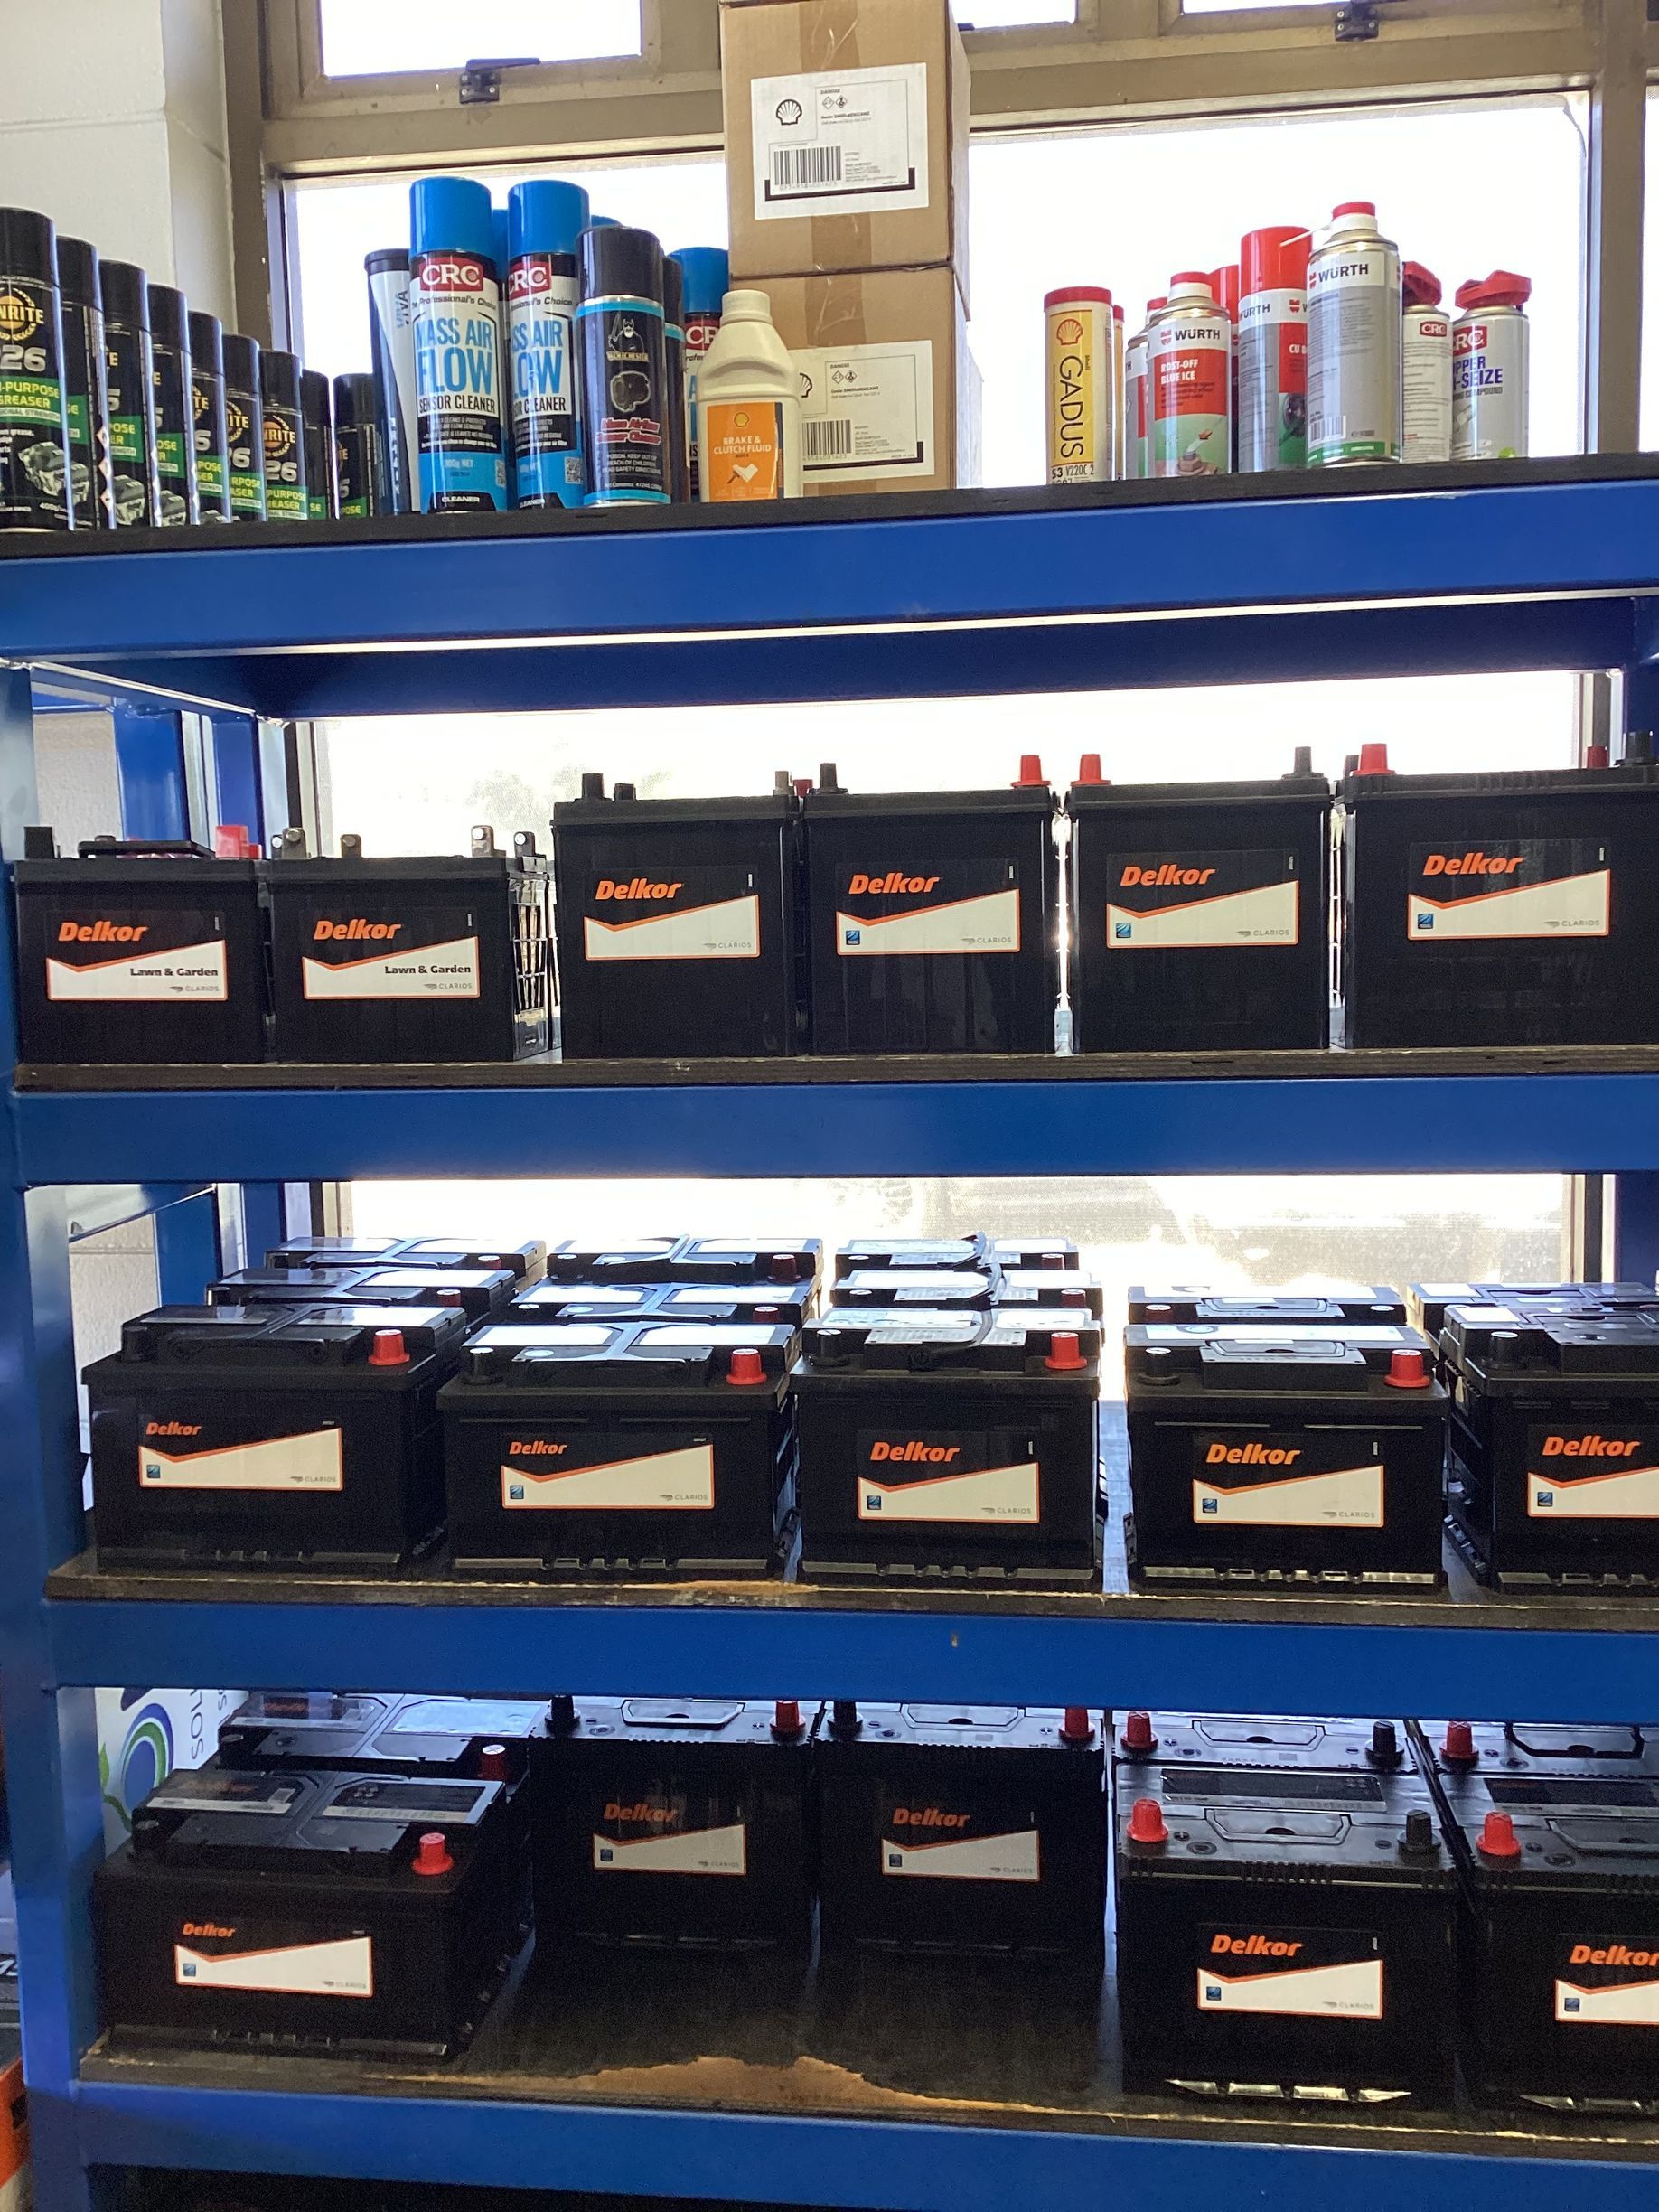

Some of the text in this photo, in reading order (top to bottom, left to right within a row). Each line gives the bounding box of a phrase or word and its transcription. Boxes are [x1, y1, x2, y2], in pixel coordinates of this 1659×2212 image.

[423, 264, 480, 286] CRC
[1318, 264, 1369, 282] WÜRTH
[420, 295, 474, 304] Proessional's
[544, 297, 573, 306] Choice
[466, 319, 492, 350] AIR
[533, 320, 563, 347] AIR
[1175, 329, 1220, 341] WÜRTH
[1421, 323, 1447, 334] CRC
[1454, 330, 1485, 351] RC
[418, 347, 492, 396] FLOW
[514, 350, 562, 398] OW
[1161, 359, 1199, 372] ROST-OFF
[1161, 371, 1195, 384] BLUE ICE
[455, 395, 495, 414] CLEANER
[524, 398, 566, 414] CEANER
[1059, 355, 1084, 458] GADUS
[713, 444, 772, 455] CLUTCH FLUID
[723, 436, 753, 445] BRAKE
[1052, 467, 1063, 479] S3
[1422, 853, 1523, 876] Delkor
[848, 873, 941, 894] Delkor
[1120, 865, 1216, 886] Delkor
[595, 878, 682, 900] Delkor
[59, 921, 148, 942] Delkor
[314, 919, 401, 940] Delkor
[130, 968, 218, 977] Lawn & Garden
[385, 965, 471, 974] Lawn & Garden
[146, 1422, 202, 1436] Delkor
[509, 1441, 567, 1455] Delkor
[870, 1442, 960, 1462] Delkor
[1206, 1443, 1300, 1465] Delkor
[1542, 1435, 1640, 1457] Delkor
[1339, 1511, 1375, 1519] CLARIOS
[603, 1803, 677, 1823] Delkor
[892, 1808, 970, 1827] Delkor
[183, 1923, 235, 1937] Delkor
[1211, 1935, 1301, 1957] Delkor
[1570, 1945, 1659, 1966] Delkor
